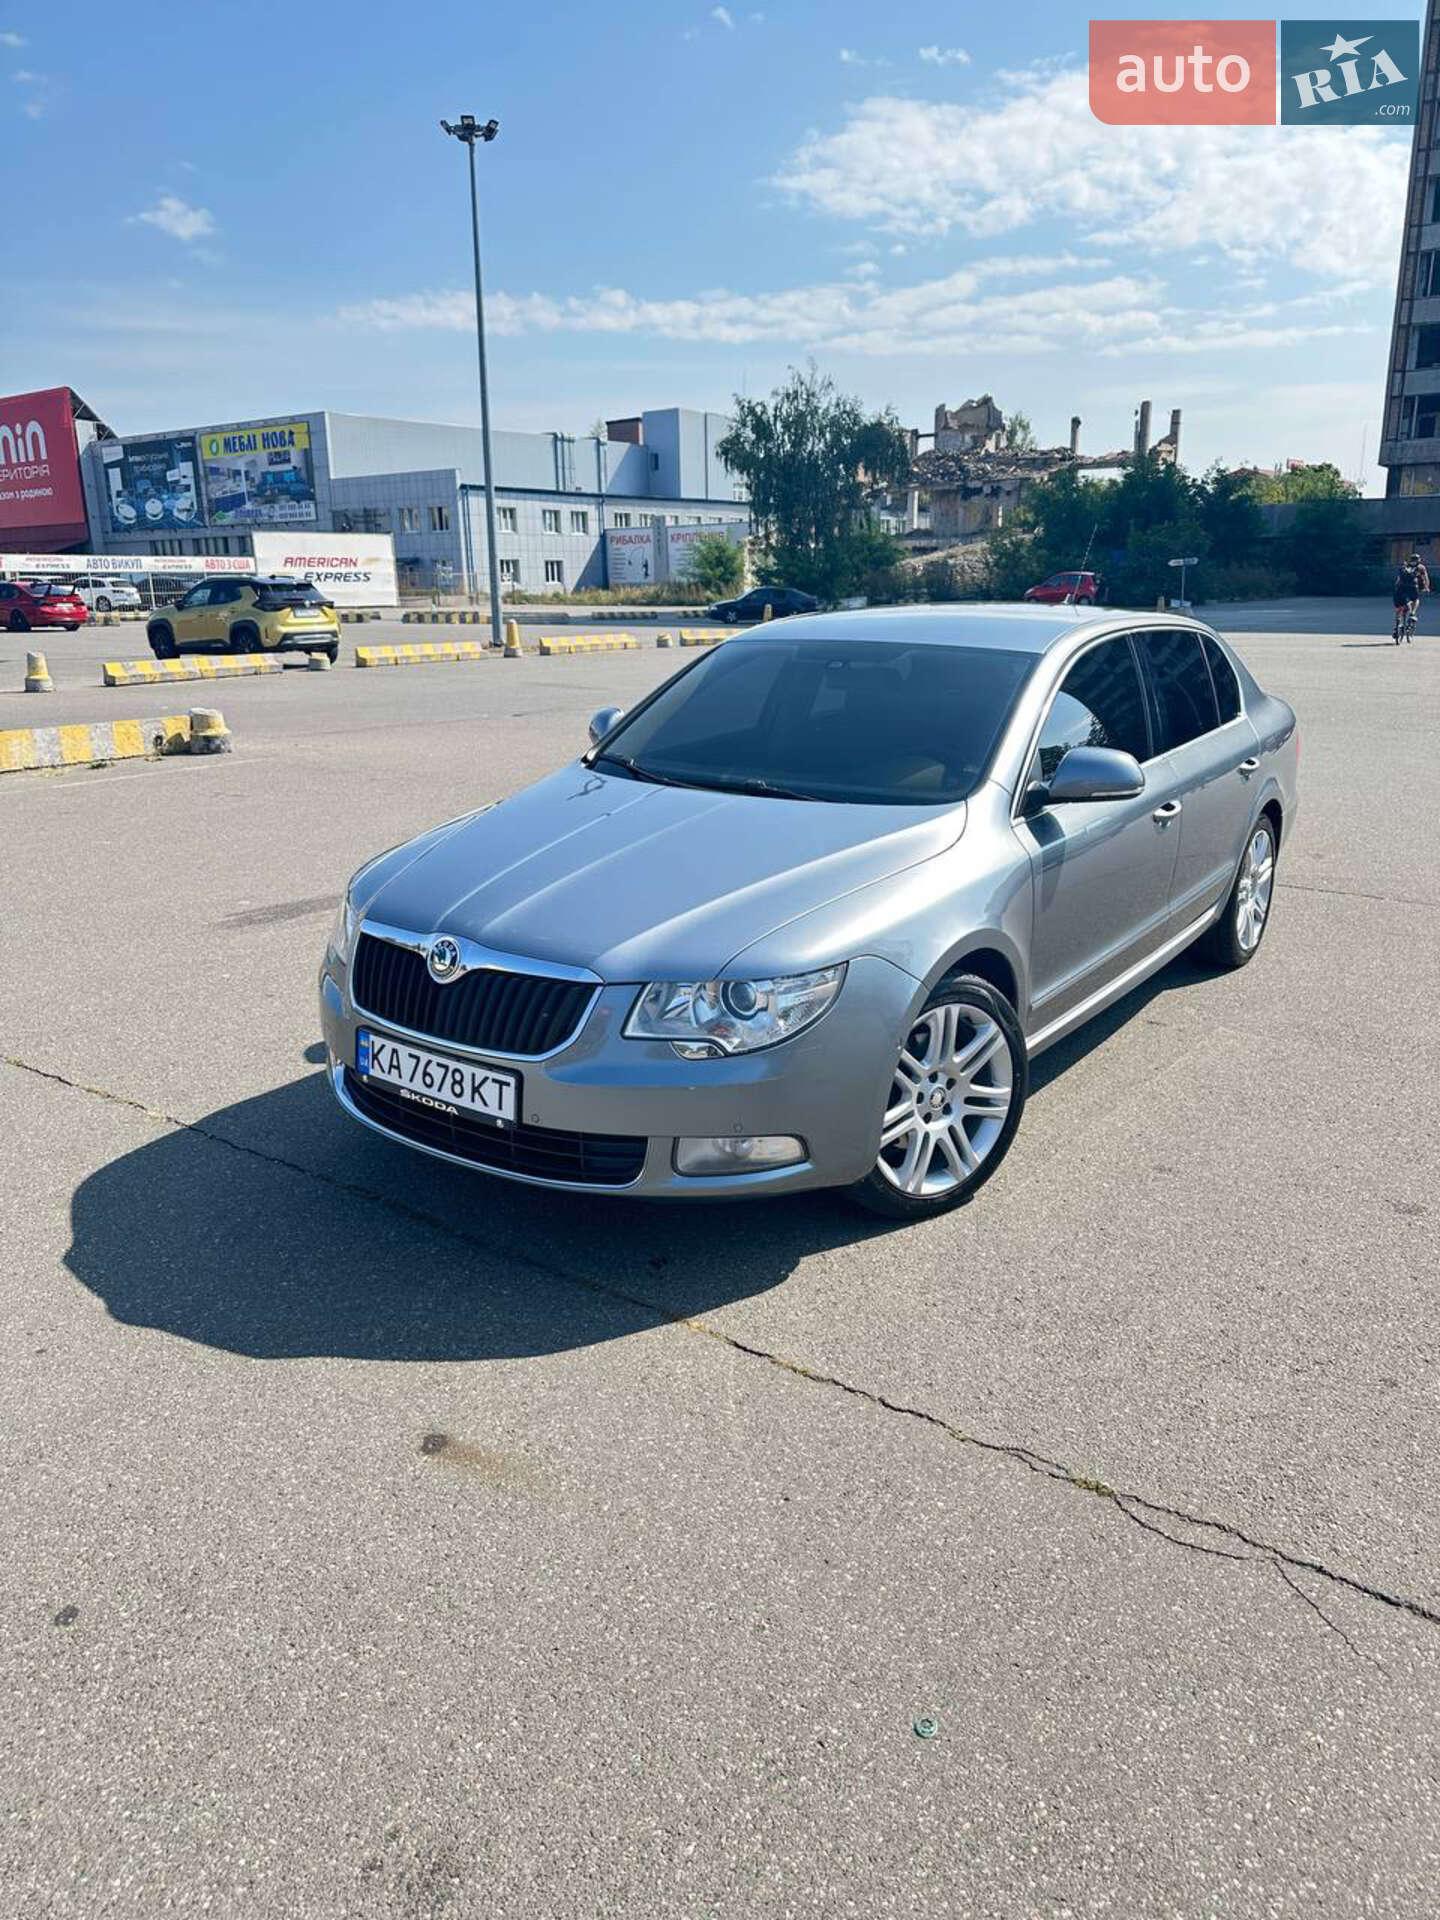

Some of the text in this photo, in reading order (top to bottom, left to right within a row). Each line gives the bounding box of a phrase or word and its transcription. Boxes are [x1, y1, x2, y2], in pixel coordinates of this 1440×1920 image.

[223, 428, 295, 454] МЕБЛІ НОВА
[610, 533, 652, 546] РИБАЛКА
[86, 558, 143, 570] АВТО ВИКУП
[204, 559, 226, 570] АВТО
[233, 559, 251, 571] США
[283, 556, 359, 569] AMERICAN
[304, 571, 372, 583] EXPRESS
